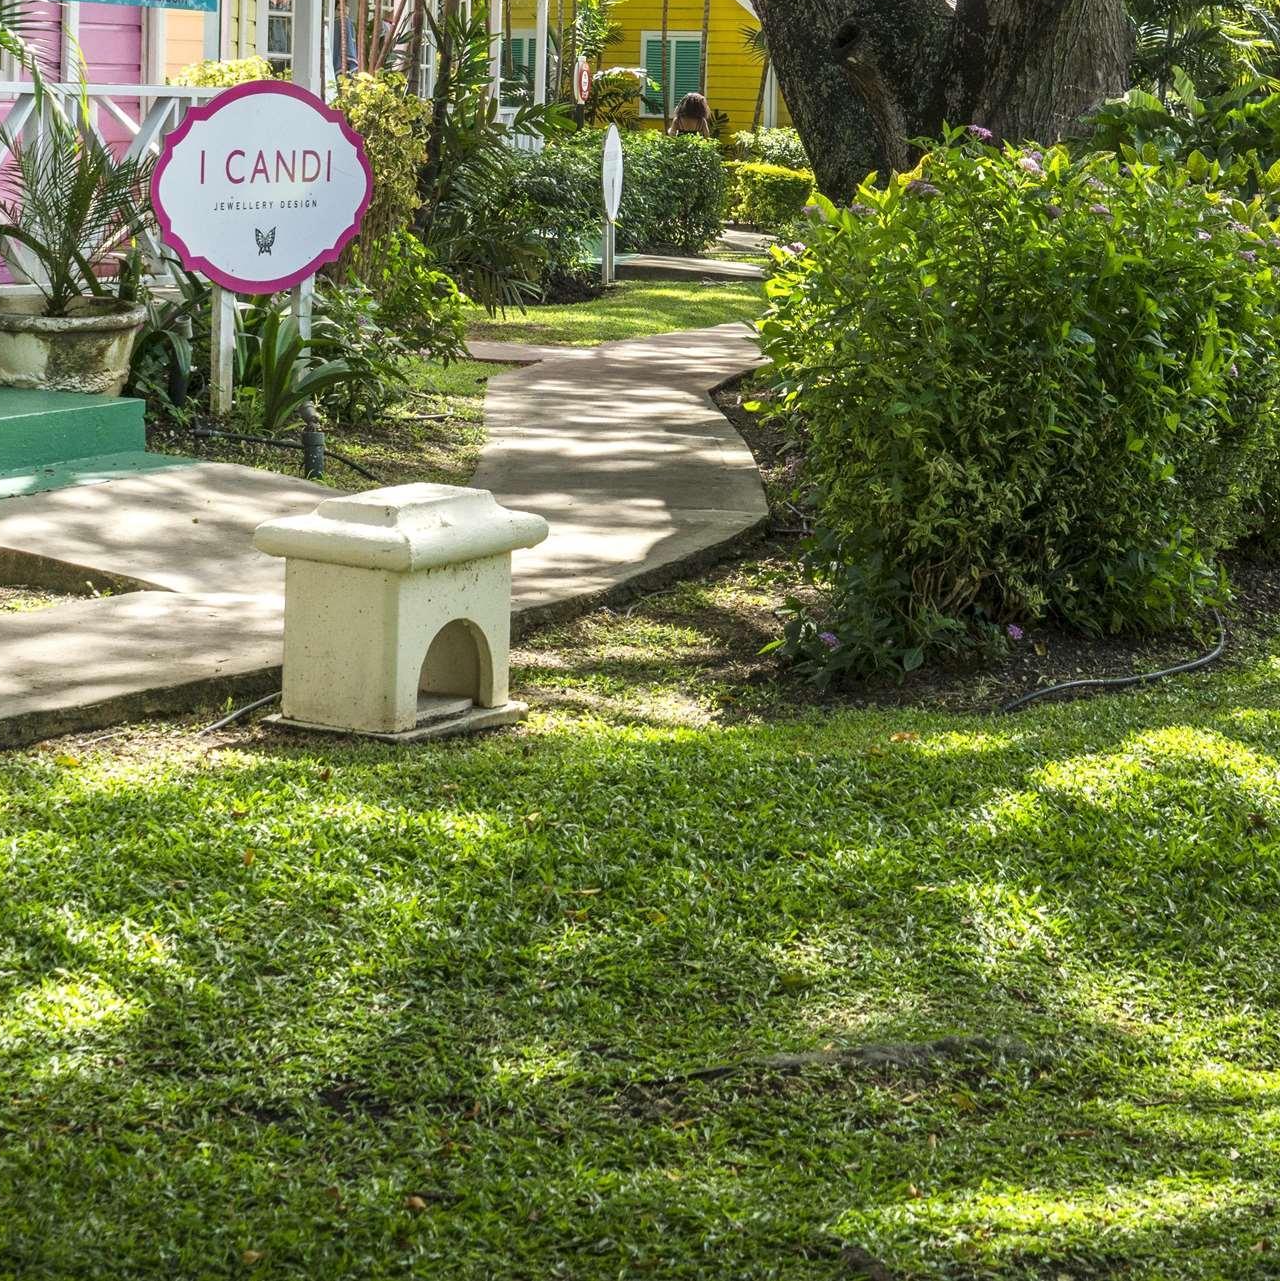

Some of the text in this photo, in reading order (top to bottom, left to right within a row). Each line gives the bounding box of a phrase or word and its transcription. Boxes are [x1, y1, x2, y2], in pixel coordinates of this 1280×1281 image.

[200, 149, 332, 185] I CANDI
[214, 200, 318, 211] JEWELLERY DESIGN
